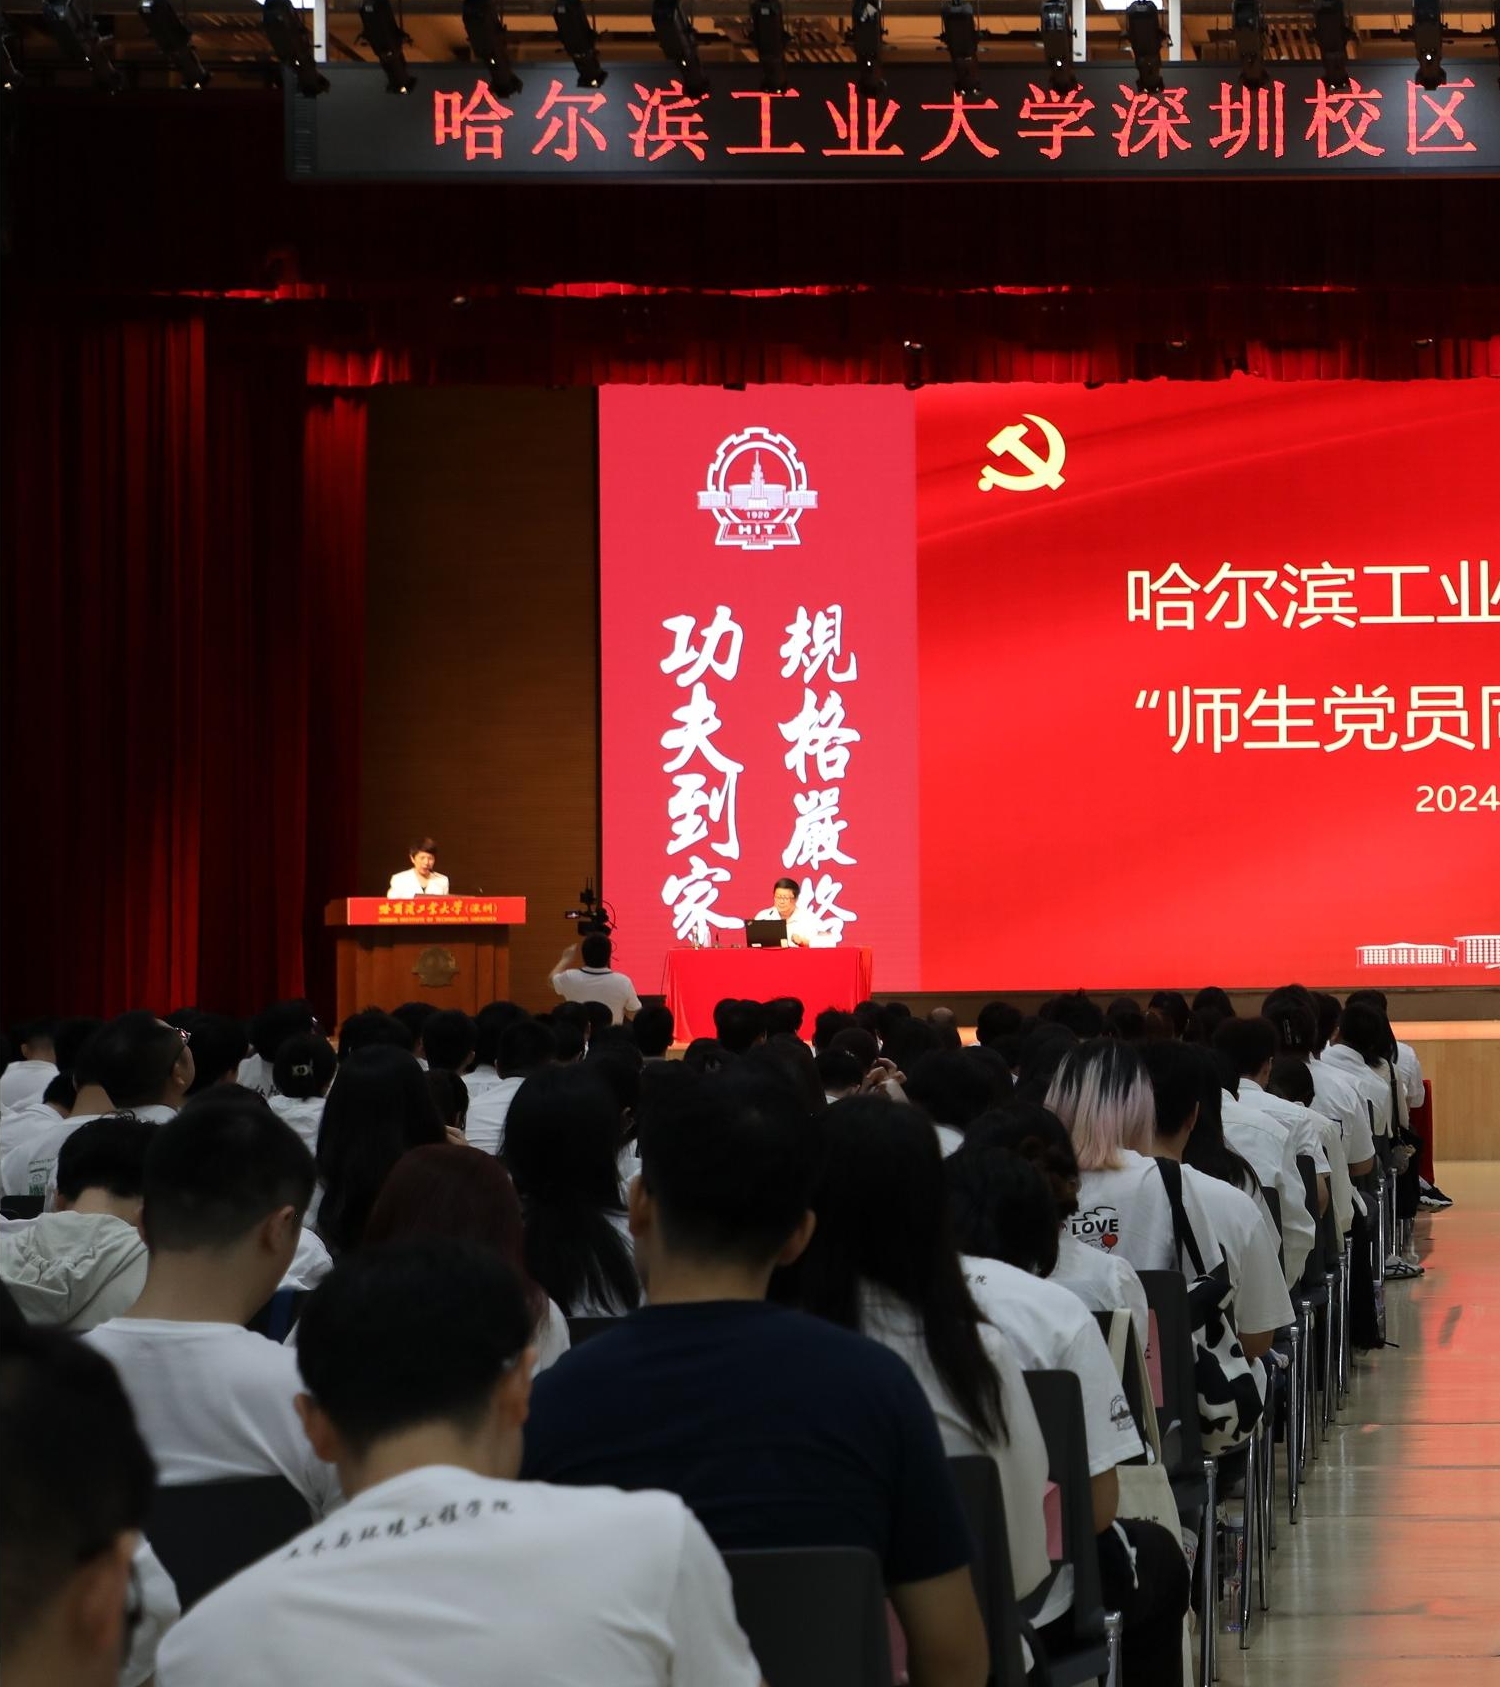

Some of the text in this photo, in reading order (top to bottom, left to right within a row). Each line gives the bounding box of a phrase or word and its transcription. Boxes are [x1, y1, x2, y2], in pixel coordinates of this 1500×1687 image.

[738, 524, 776, 535] HIT
[659, 605, 745, 945] 功夫到家
[1071, 1219, 1119, 1236] LOVE
